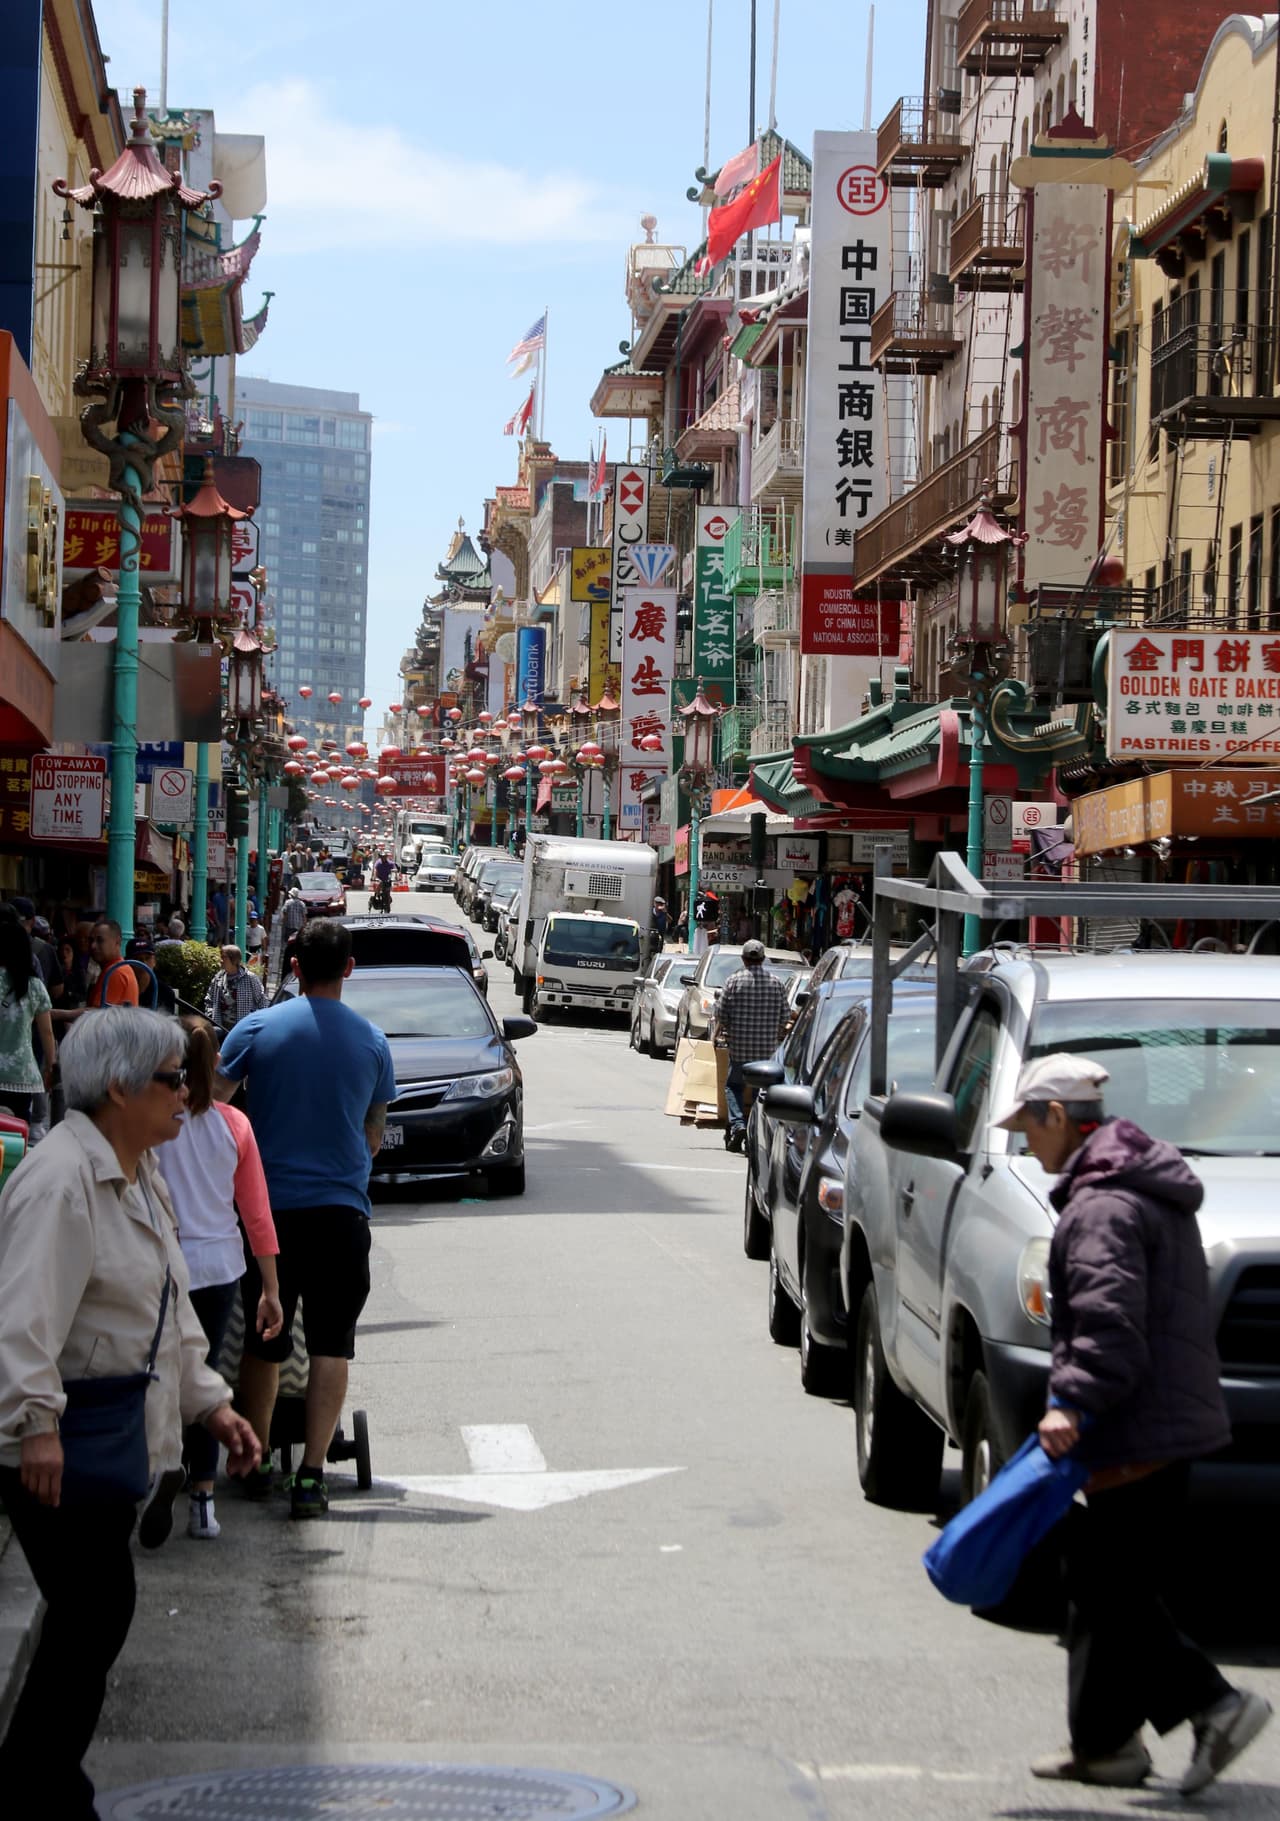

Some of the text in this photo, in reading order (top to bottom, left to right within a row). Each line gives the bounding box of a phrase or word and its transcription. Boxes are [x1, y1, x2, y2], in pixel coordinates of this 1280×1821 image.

[835, 239, 878, 519] 中国工商银行
[142, 521, 168, 536] hop
[818, 603, 861, 615] COMMERCIAL
[813, 632, 890, 644] NATIONAL ASSOCIATON
[1120, 675, 1181, 697] GOLDEN
[1189, 677, 1228, 698] GATE
[1120, 737, 1211, 751] PASTRIES
[40, 758, 99, 769] TOW-AWAY
[34, 770, 101, 790] NO STOPPING
[1183, 779, 1280, 799] 中秋月
[54, 793, 82, 807] ANY
[52, 809, 83, 824] TIME
[577, 960, 606, 969] ISUZU
